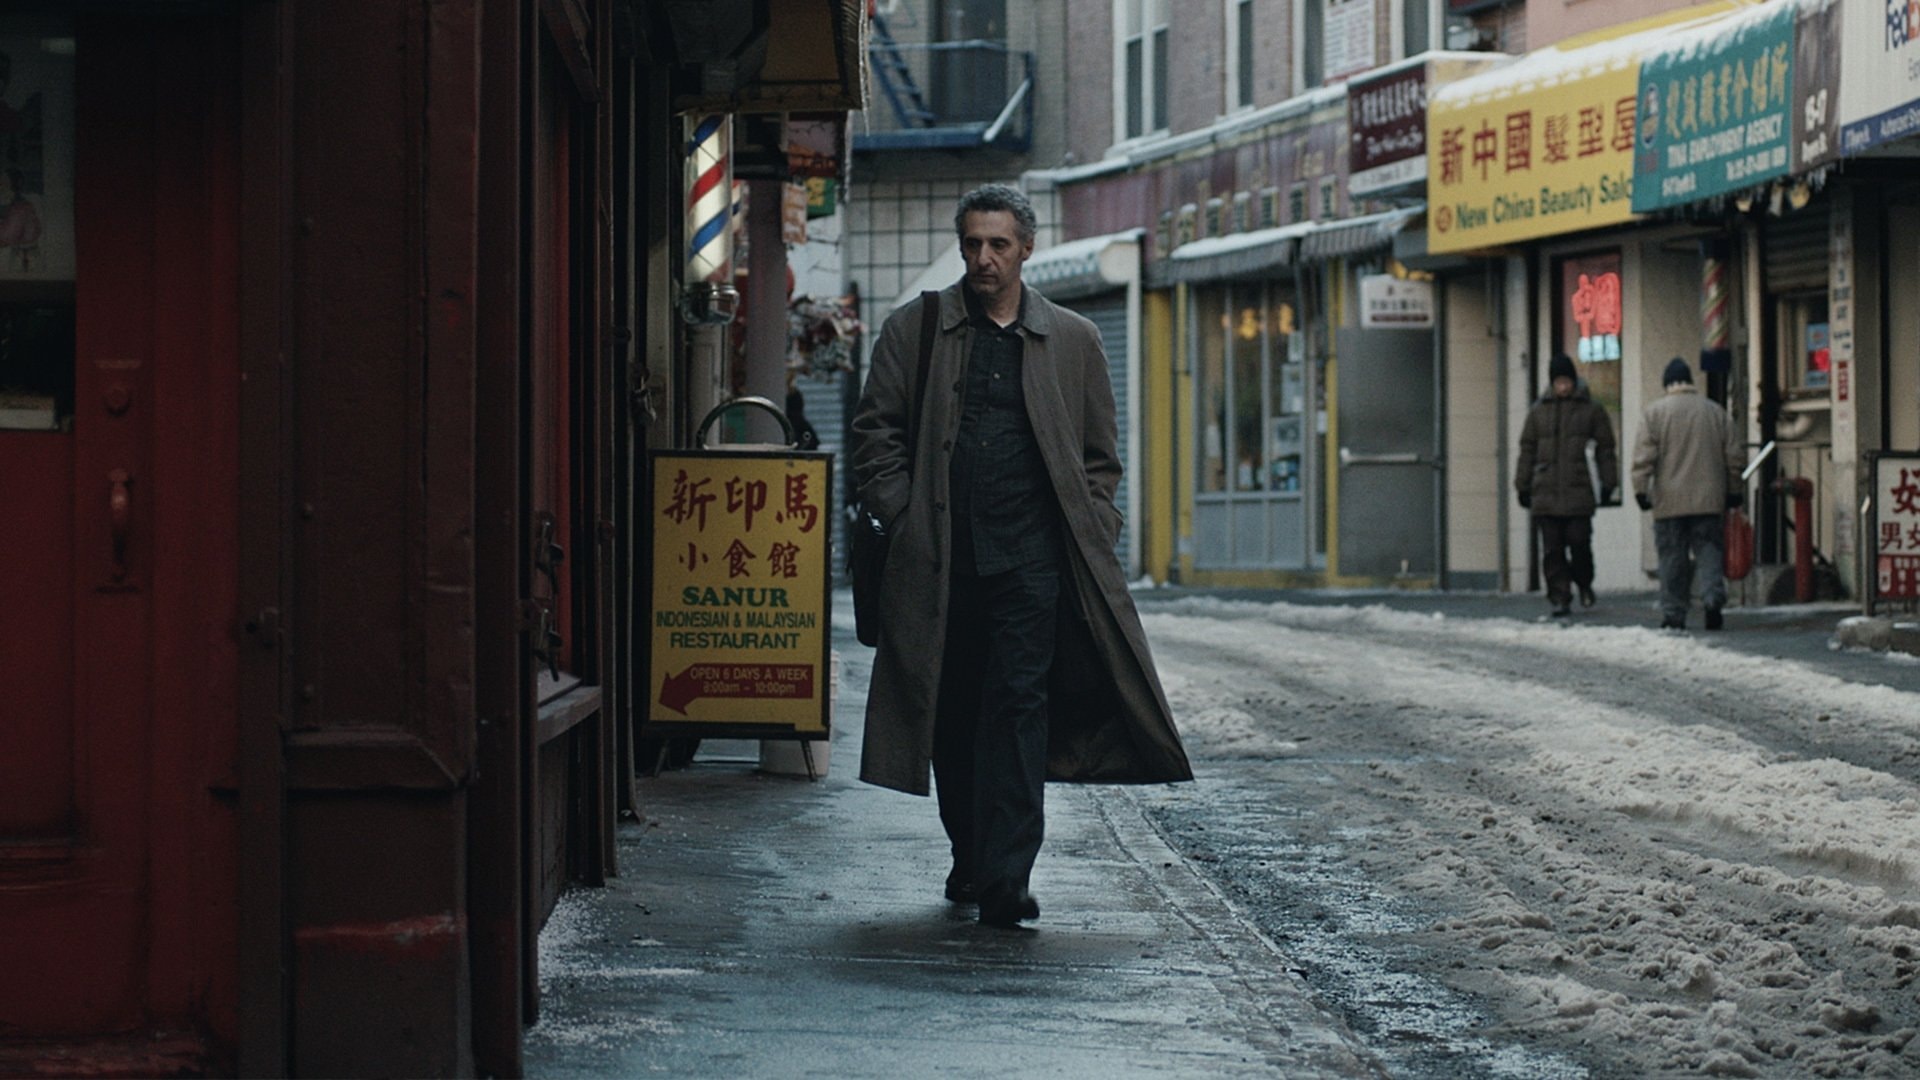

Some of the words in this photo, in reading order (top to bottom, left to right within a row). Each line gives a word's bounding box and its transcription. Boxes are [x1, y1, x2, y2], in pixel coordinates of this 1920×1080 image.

[1746, 112, 1784, 147] AGENCY
[1456, 202, 1488, 230] New
[1493, 191, 1535, 223] China
[1540, 183, 1594, 214] Beauty
[662, 469, 818, 533] 新印馬
[678, 538, 801, 579] 小食館
[682, 586, 789, 607] SANUR
[656, 610, 730, 628] INDONESIAN
[733, 611, 742, 628] &
[746, 611, 816, 629] MALAYSIAN
[670, 632, 800, 649] RESTAURANT
[690, 667, 720, 680] OPEN
[723, 667, 730, 680] 6
[733, 667, 760, 680] DAYS
[764, 667, 772, 680] A
[777, 667, 808, 680] WEEK
[755, 682, 796, 695] 10:00pm
